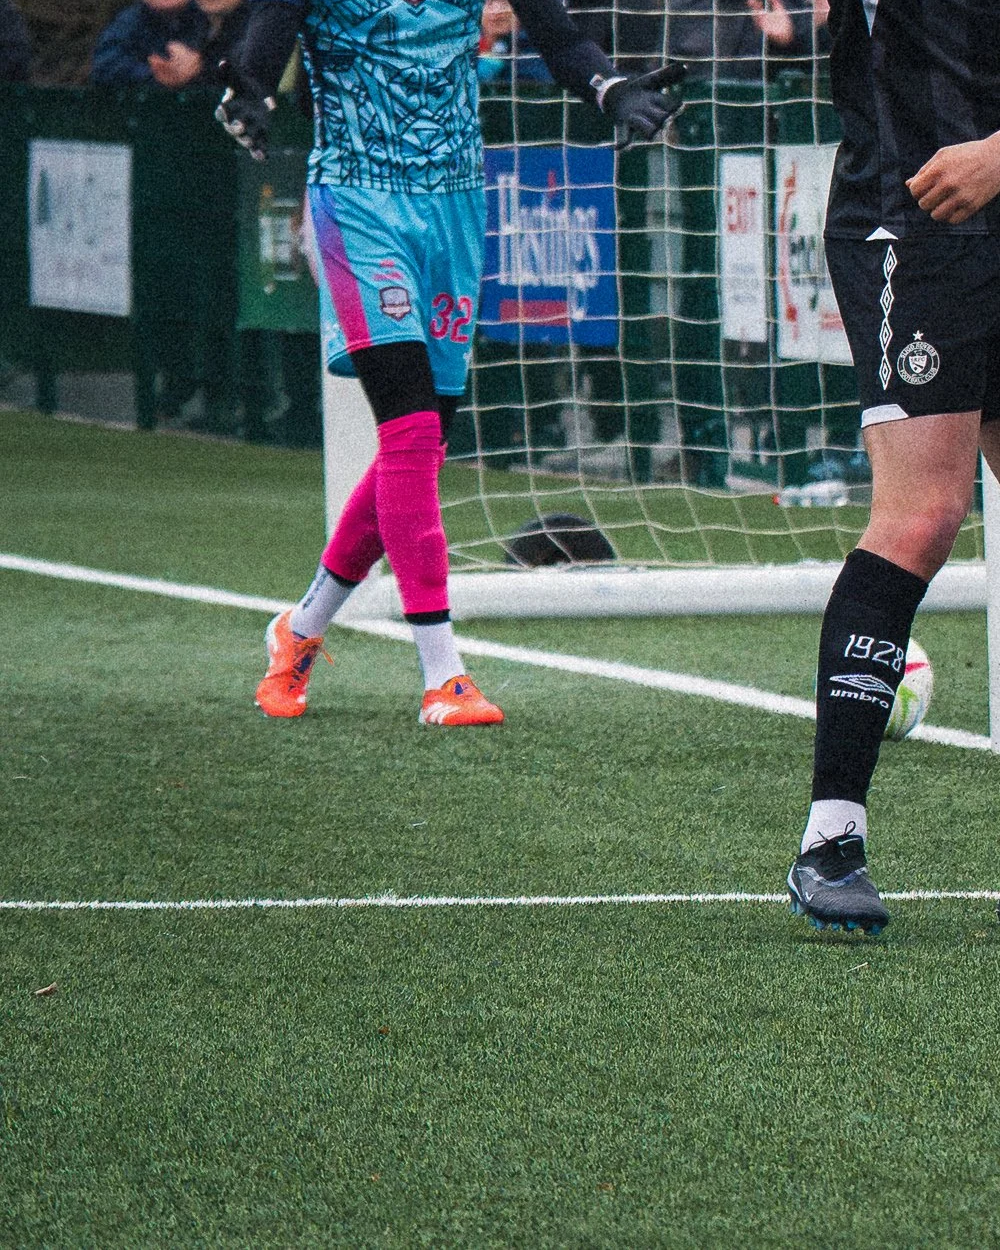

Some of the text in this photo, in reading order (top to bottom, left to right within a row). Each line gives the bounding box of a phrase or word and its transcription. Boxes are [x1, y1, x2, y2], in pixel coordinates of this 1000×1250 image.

[429, 292, 473, 344] 32
[844, 634, 904, 672] 1928
[830, 689, 889, 709] umbro
